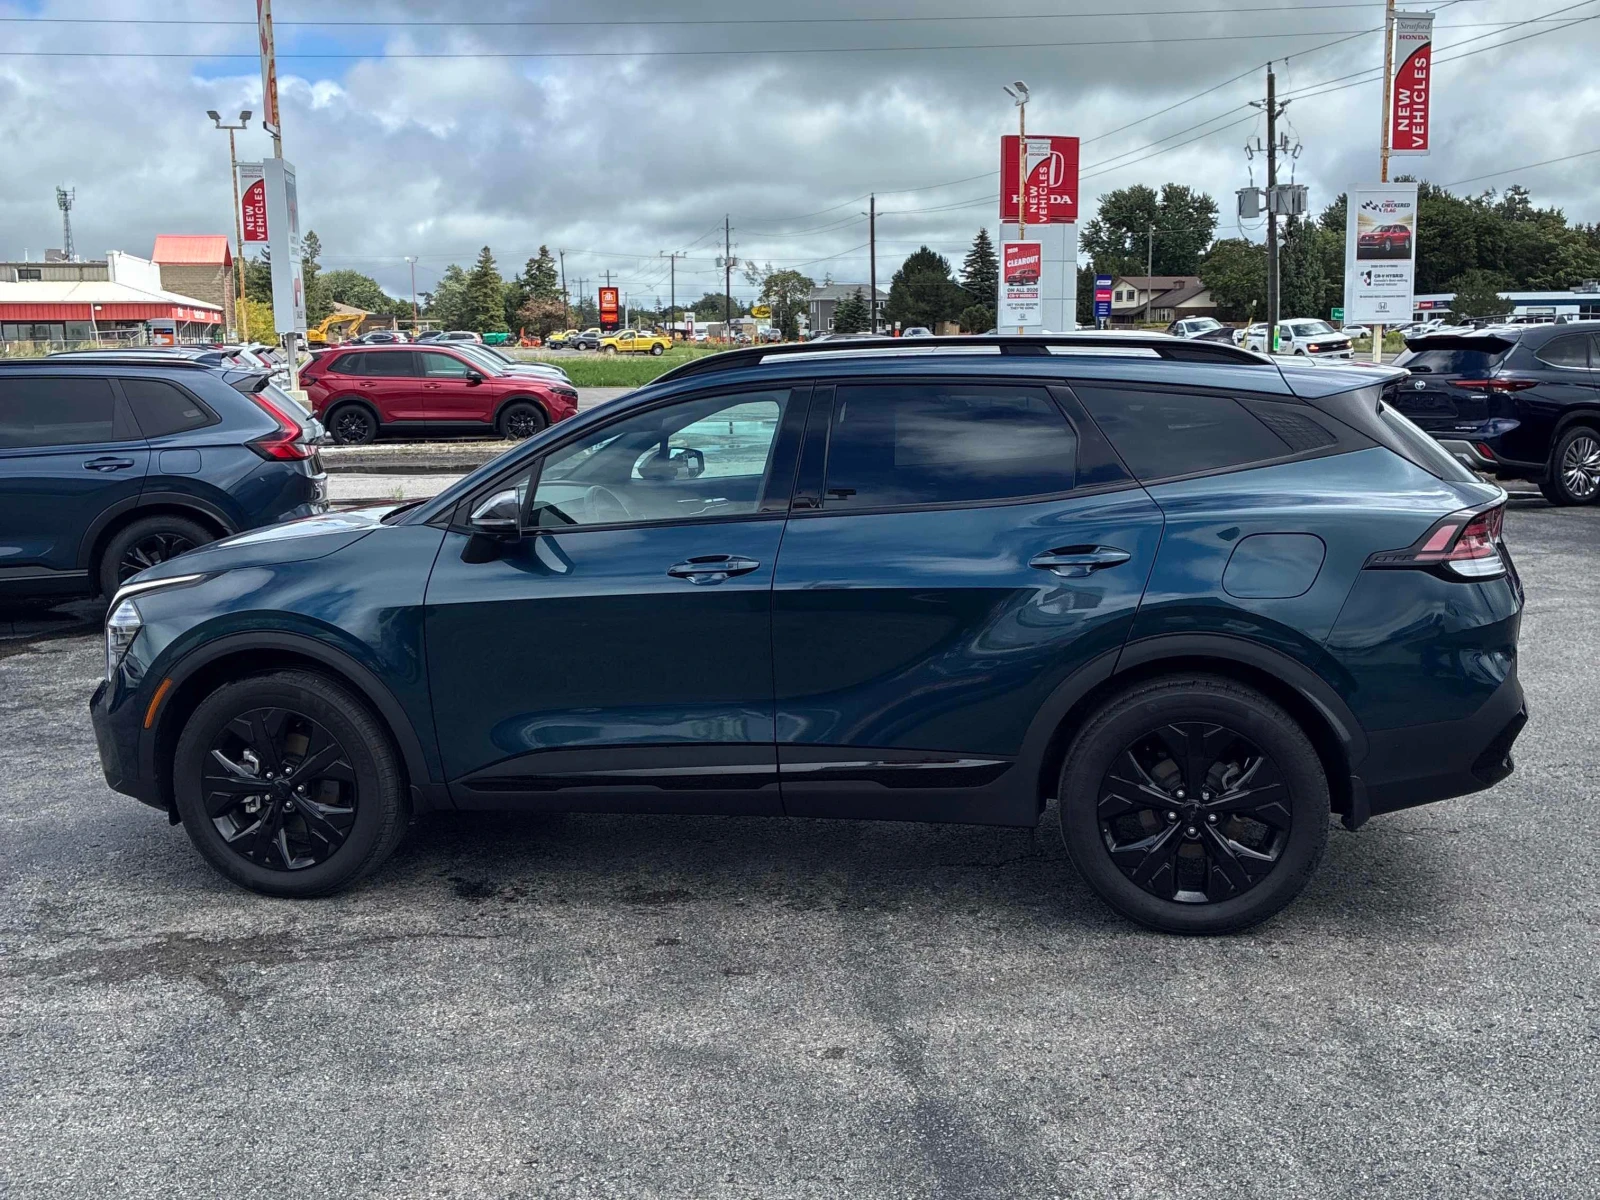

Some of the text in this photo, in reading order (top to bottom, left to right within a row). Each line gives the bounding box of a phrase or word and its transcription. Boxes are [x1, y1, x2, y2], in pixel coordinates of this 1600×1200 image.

[1400, 22, 1431, 31] Stratford
[1398, 88, 1410, 130] NEW
[1412, 57, 1427, 147] VEHICLES
[1029, 185, 1038, 212] NEW
[1039, 166, 1048, 222] VEHICLES
[245, 205, 255, 231] NEW
[254, 187, 265, 240] VEHICLES
[1007, 255, 1039, 268] CLEAROUT
